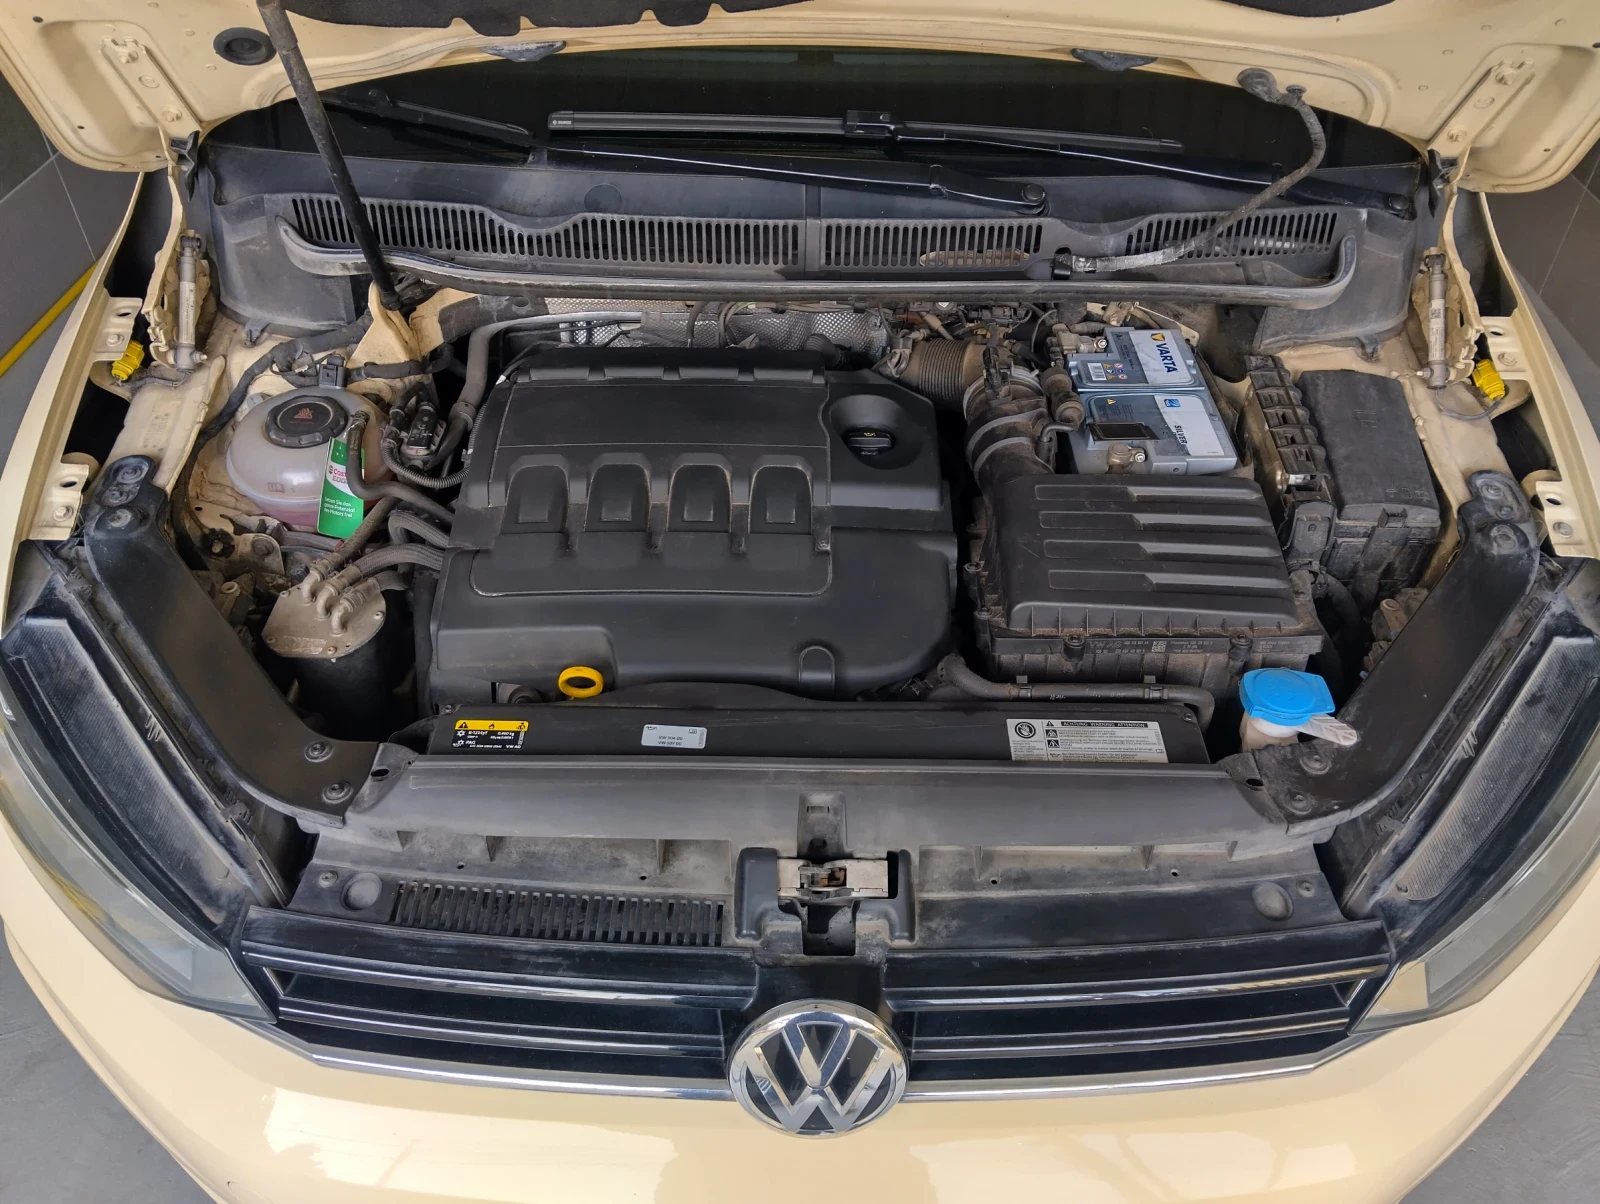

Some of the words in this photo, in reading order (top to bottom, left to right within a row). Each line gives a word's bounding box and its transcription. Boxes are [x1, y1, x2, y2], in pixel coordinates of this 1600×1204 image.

[1155, 343, 1178, 373] VARTA
[1174, 425, 1188, 444] SILVER
[735, 1008, 901, 1135] VW
